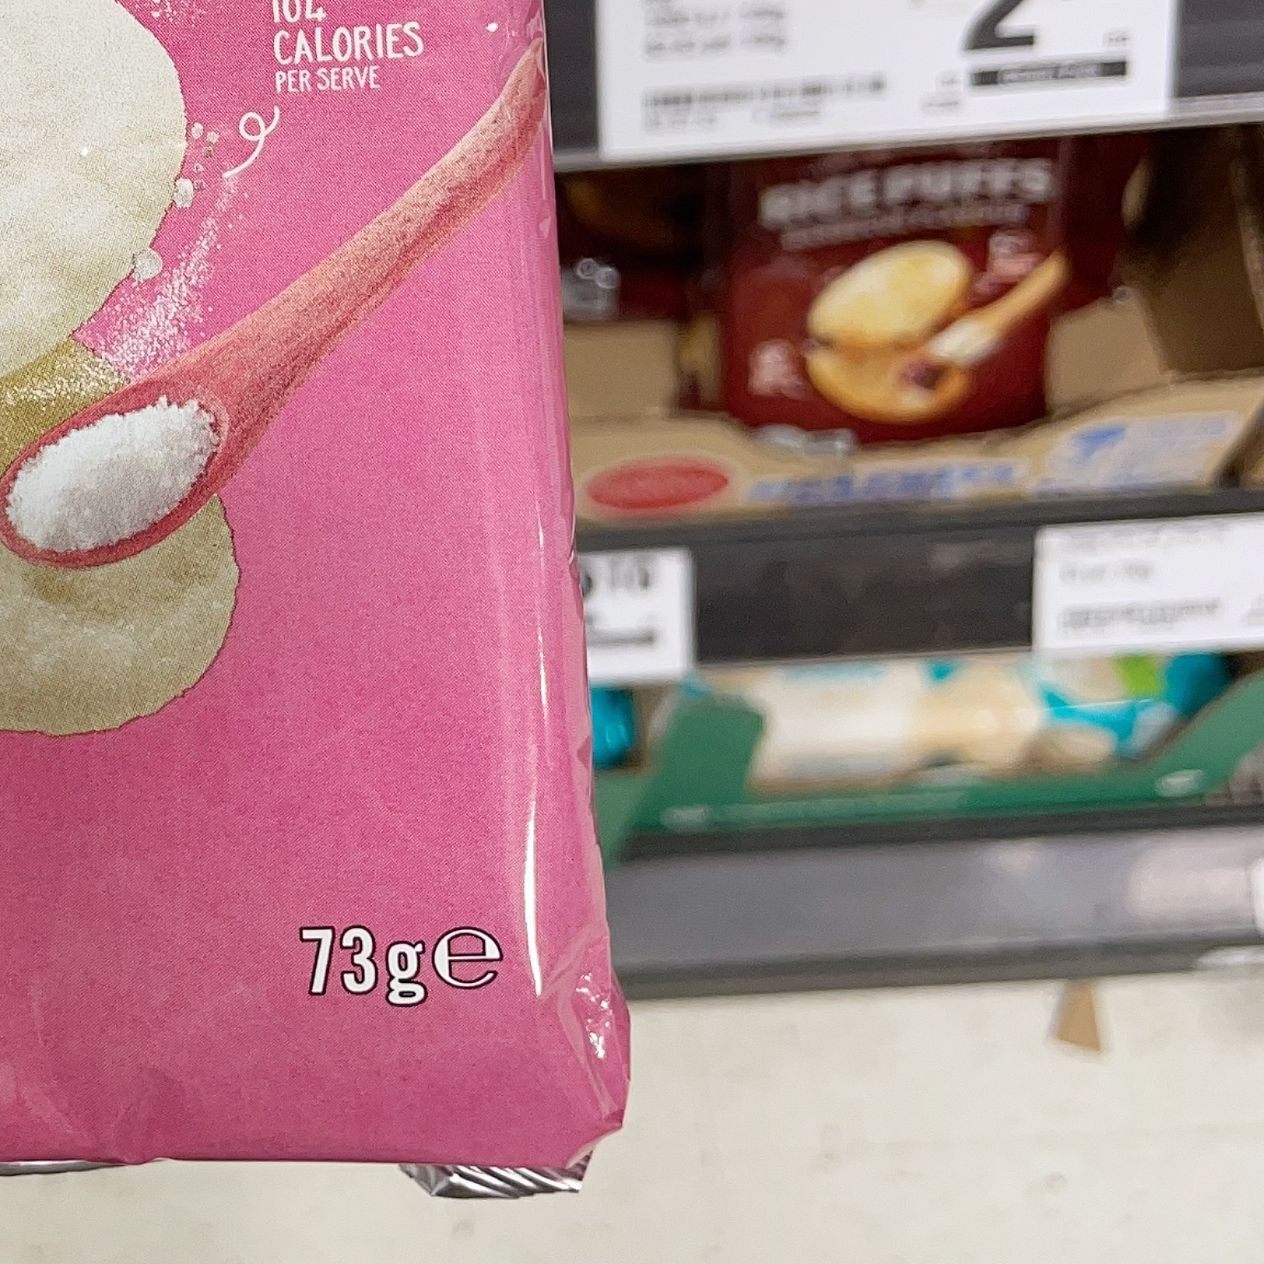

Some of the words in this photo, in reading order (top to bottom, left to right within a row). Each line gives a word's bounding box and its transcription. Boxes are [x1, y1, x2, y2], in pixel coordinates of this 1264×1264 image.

[273, 21, 425, 66] CALORIES
[274, 69, 312, 94] PER
[316, 65, 382, 92] SERVE
